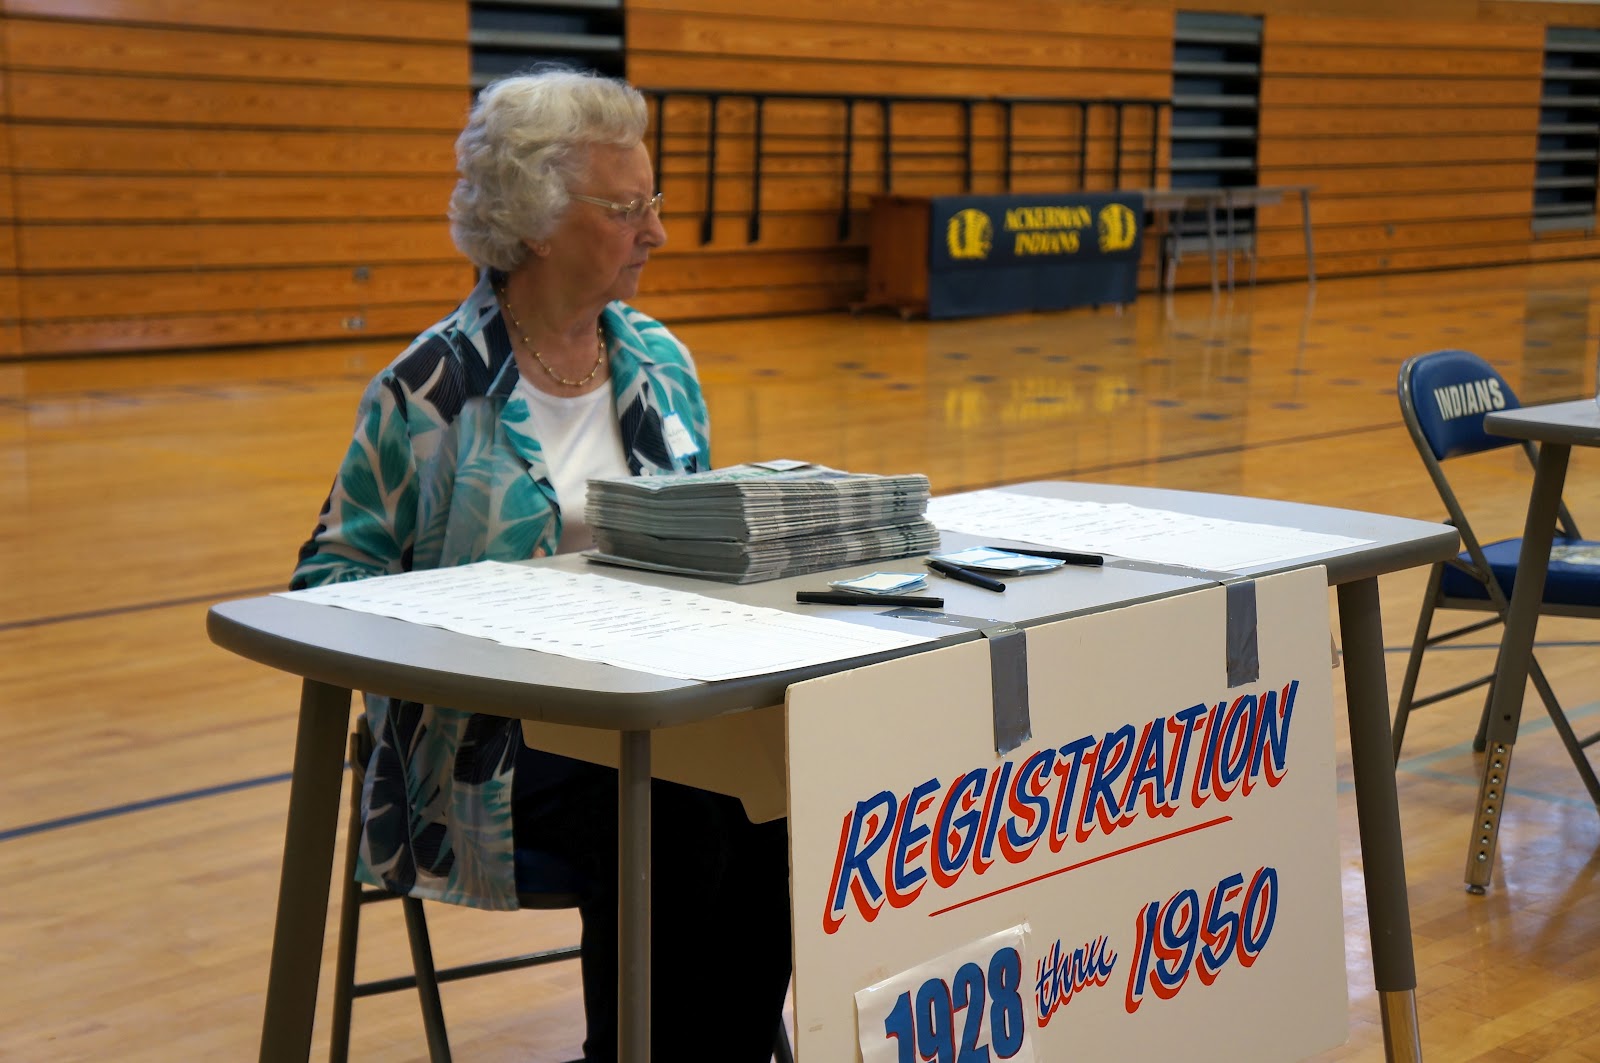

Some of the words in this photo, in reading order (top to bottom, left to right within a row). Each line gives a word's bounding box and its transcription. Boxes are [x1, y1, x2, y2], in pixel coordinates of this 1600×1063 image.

[1015, 231, 1080, 256] INDIANS
[1434, 377, 1506, 421] INDIANS
[823, 680, 1299, 934] REGISTRATION
[884, 946, 1025, 1063] 1928
[1035, 935, 1118, 1028] thru
[1125, 866, 1278, 1014] 1950
